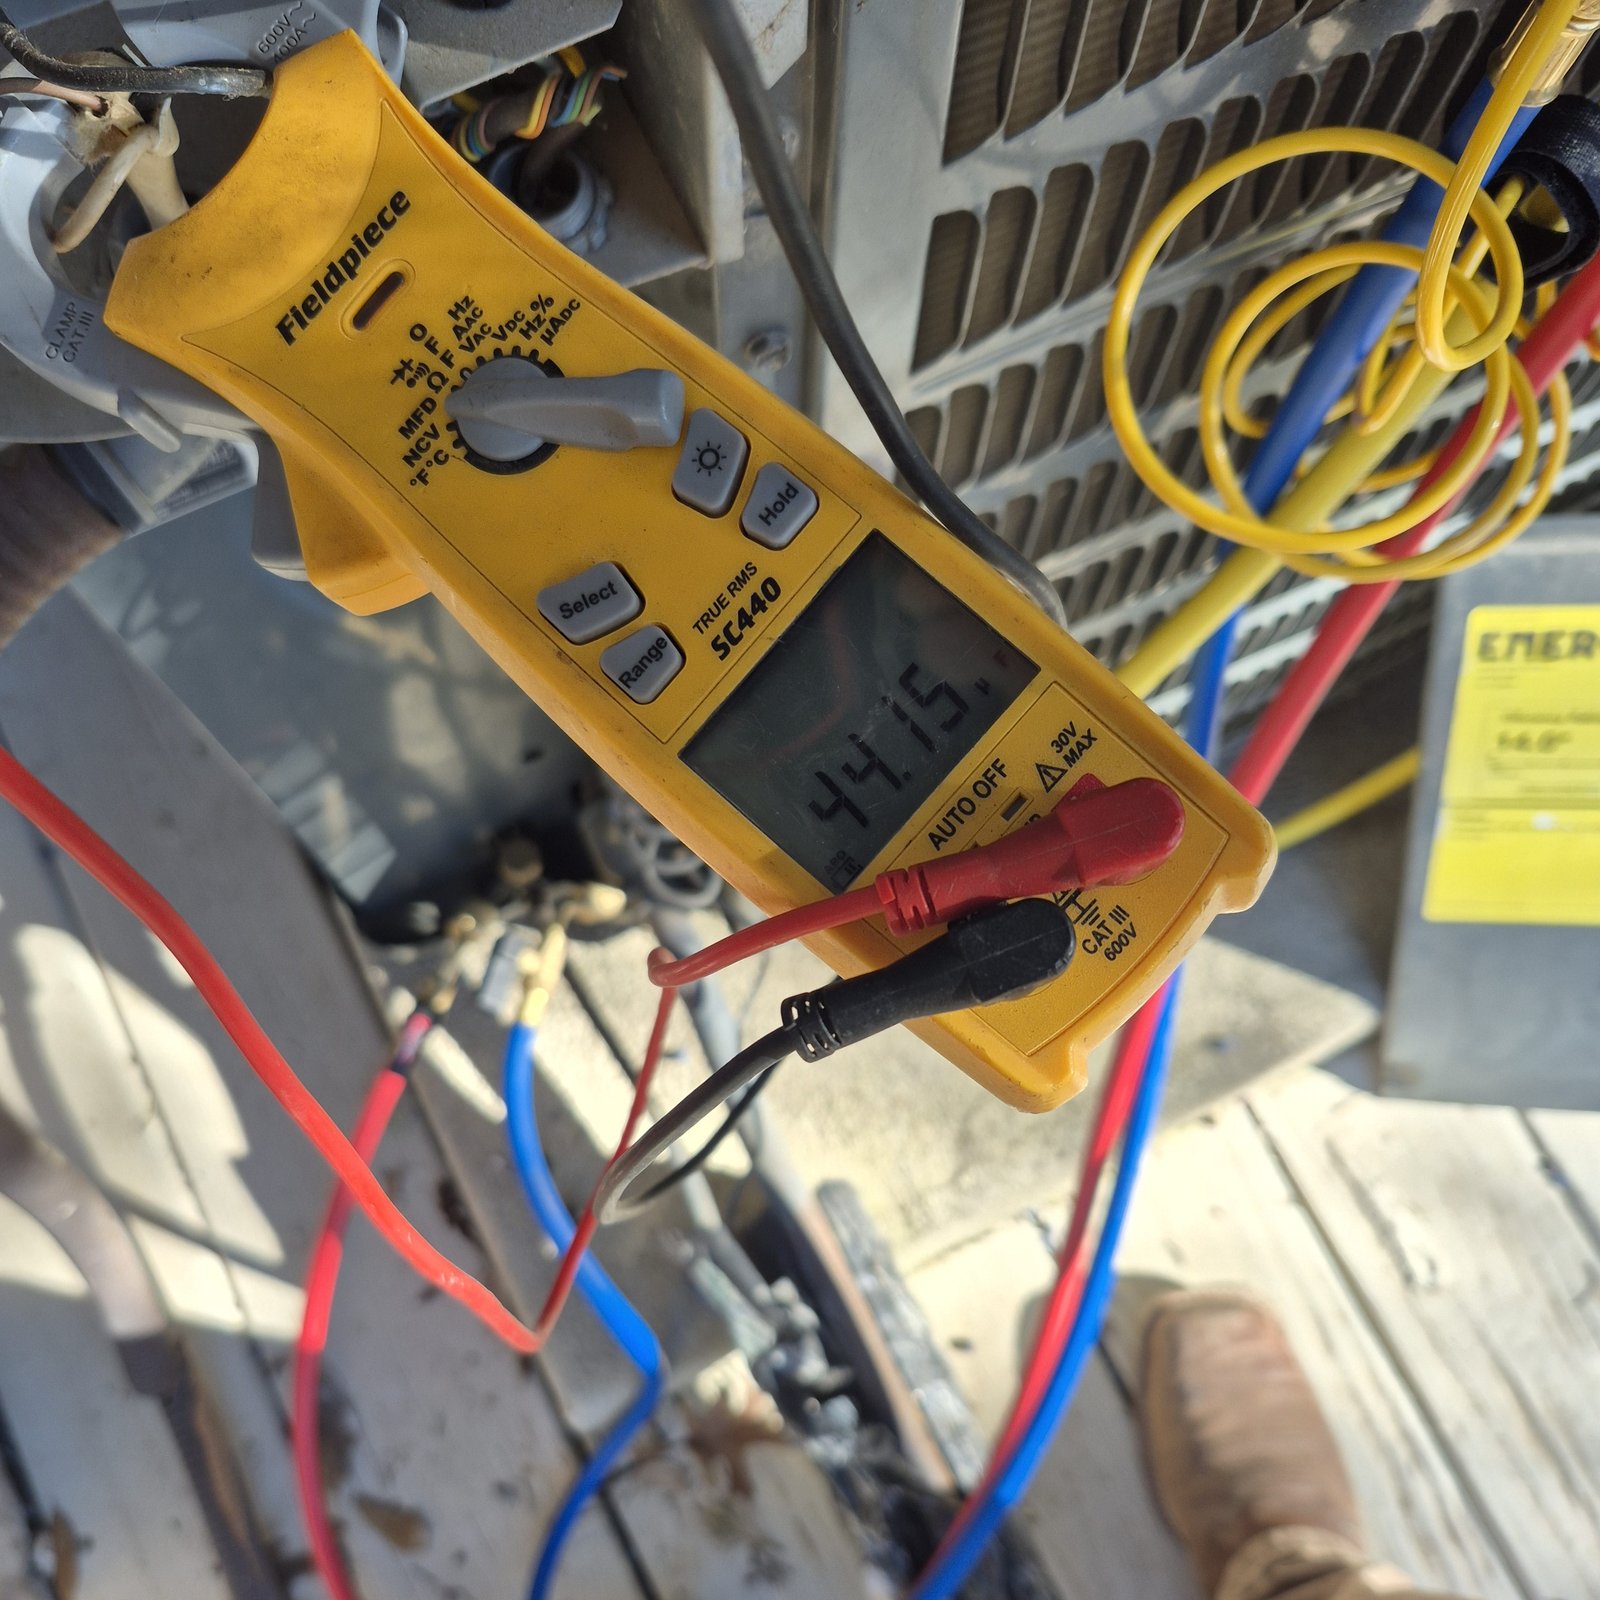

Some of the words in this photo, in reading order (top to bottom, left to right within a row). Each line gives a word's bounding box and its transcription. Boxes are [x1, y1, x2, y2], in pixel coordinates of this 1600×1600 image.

[275, 190, 411, 347] Fieldpiece
[46, 302, 76, 359] CLAMP
[448, 295, 475, 321] Hz
[398, 397, 438, 440] MFD
[402, 422, 442, 468] NCV
[758, 482, 799, 527] Hold
[559, 580, 618, 620] Select
[692, 593, 730, 635] TRUE
[726, 561, 758, 598] RMS
[710, 576, 782, 661] SC440
[618, 635, 668, 689] Range
[808, 662, 970, 828] 44.15
[1051, 720, 1077, 753] 30V
[1063, 727, 1098, 768] MAX
[928, 796, 977, 851] AUTO
[972, 757, 1007, 799] OFF
[1081, 919, 1114, 954] CAT
[1108, 904, 1130, 925] III
[1104, 921, 1137, 961] 600V
